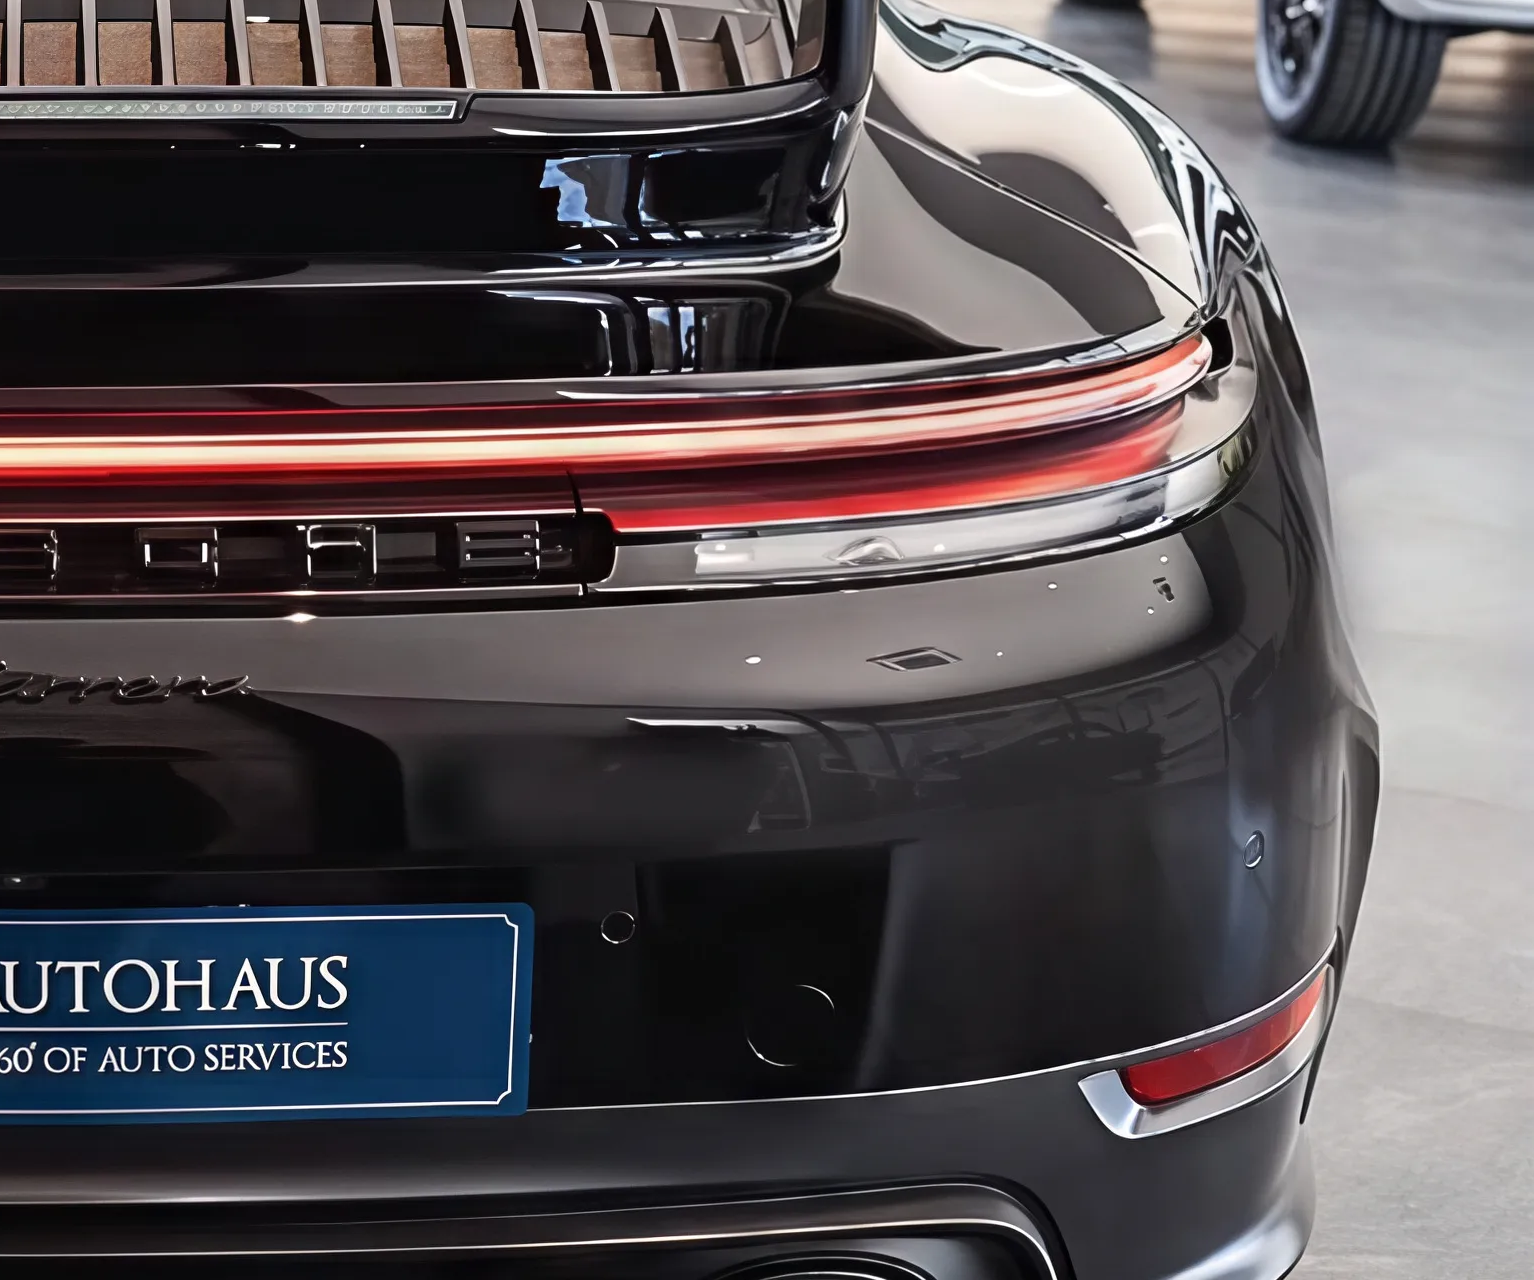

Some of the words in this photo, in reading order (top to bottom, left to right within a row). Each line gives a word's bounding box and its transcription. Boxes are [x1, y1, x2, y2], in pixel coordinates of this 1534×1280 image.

[43, 1046, 88, 1073] OF
[97, 1044, 196, 1073] AUTO
[203, 1041, 348, 1072] SERVICES
